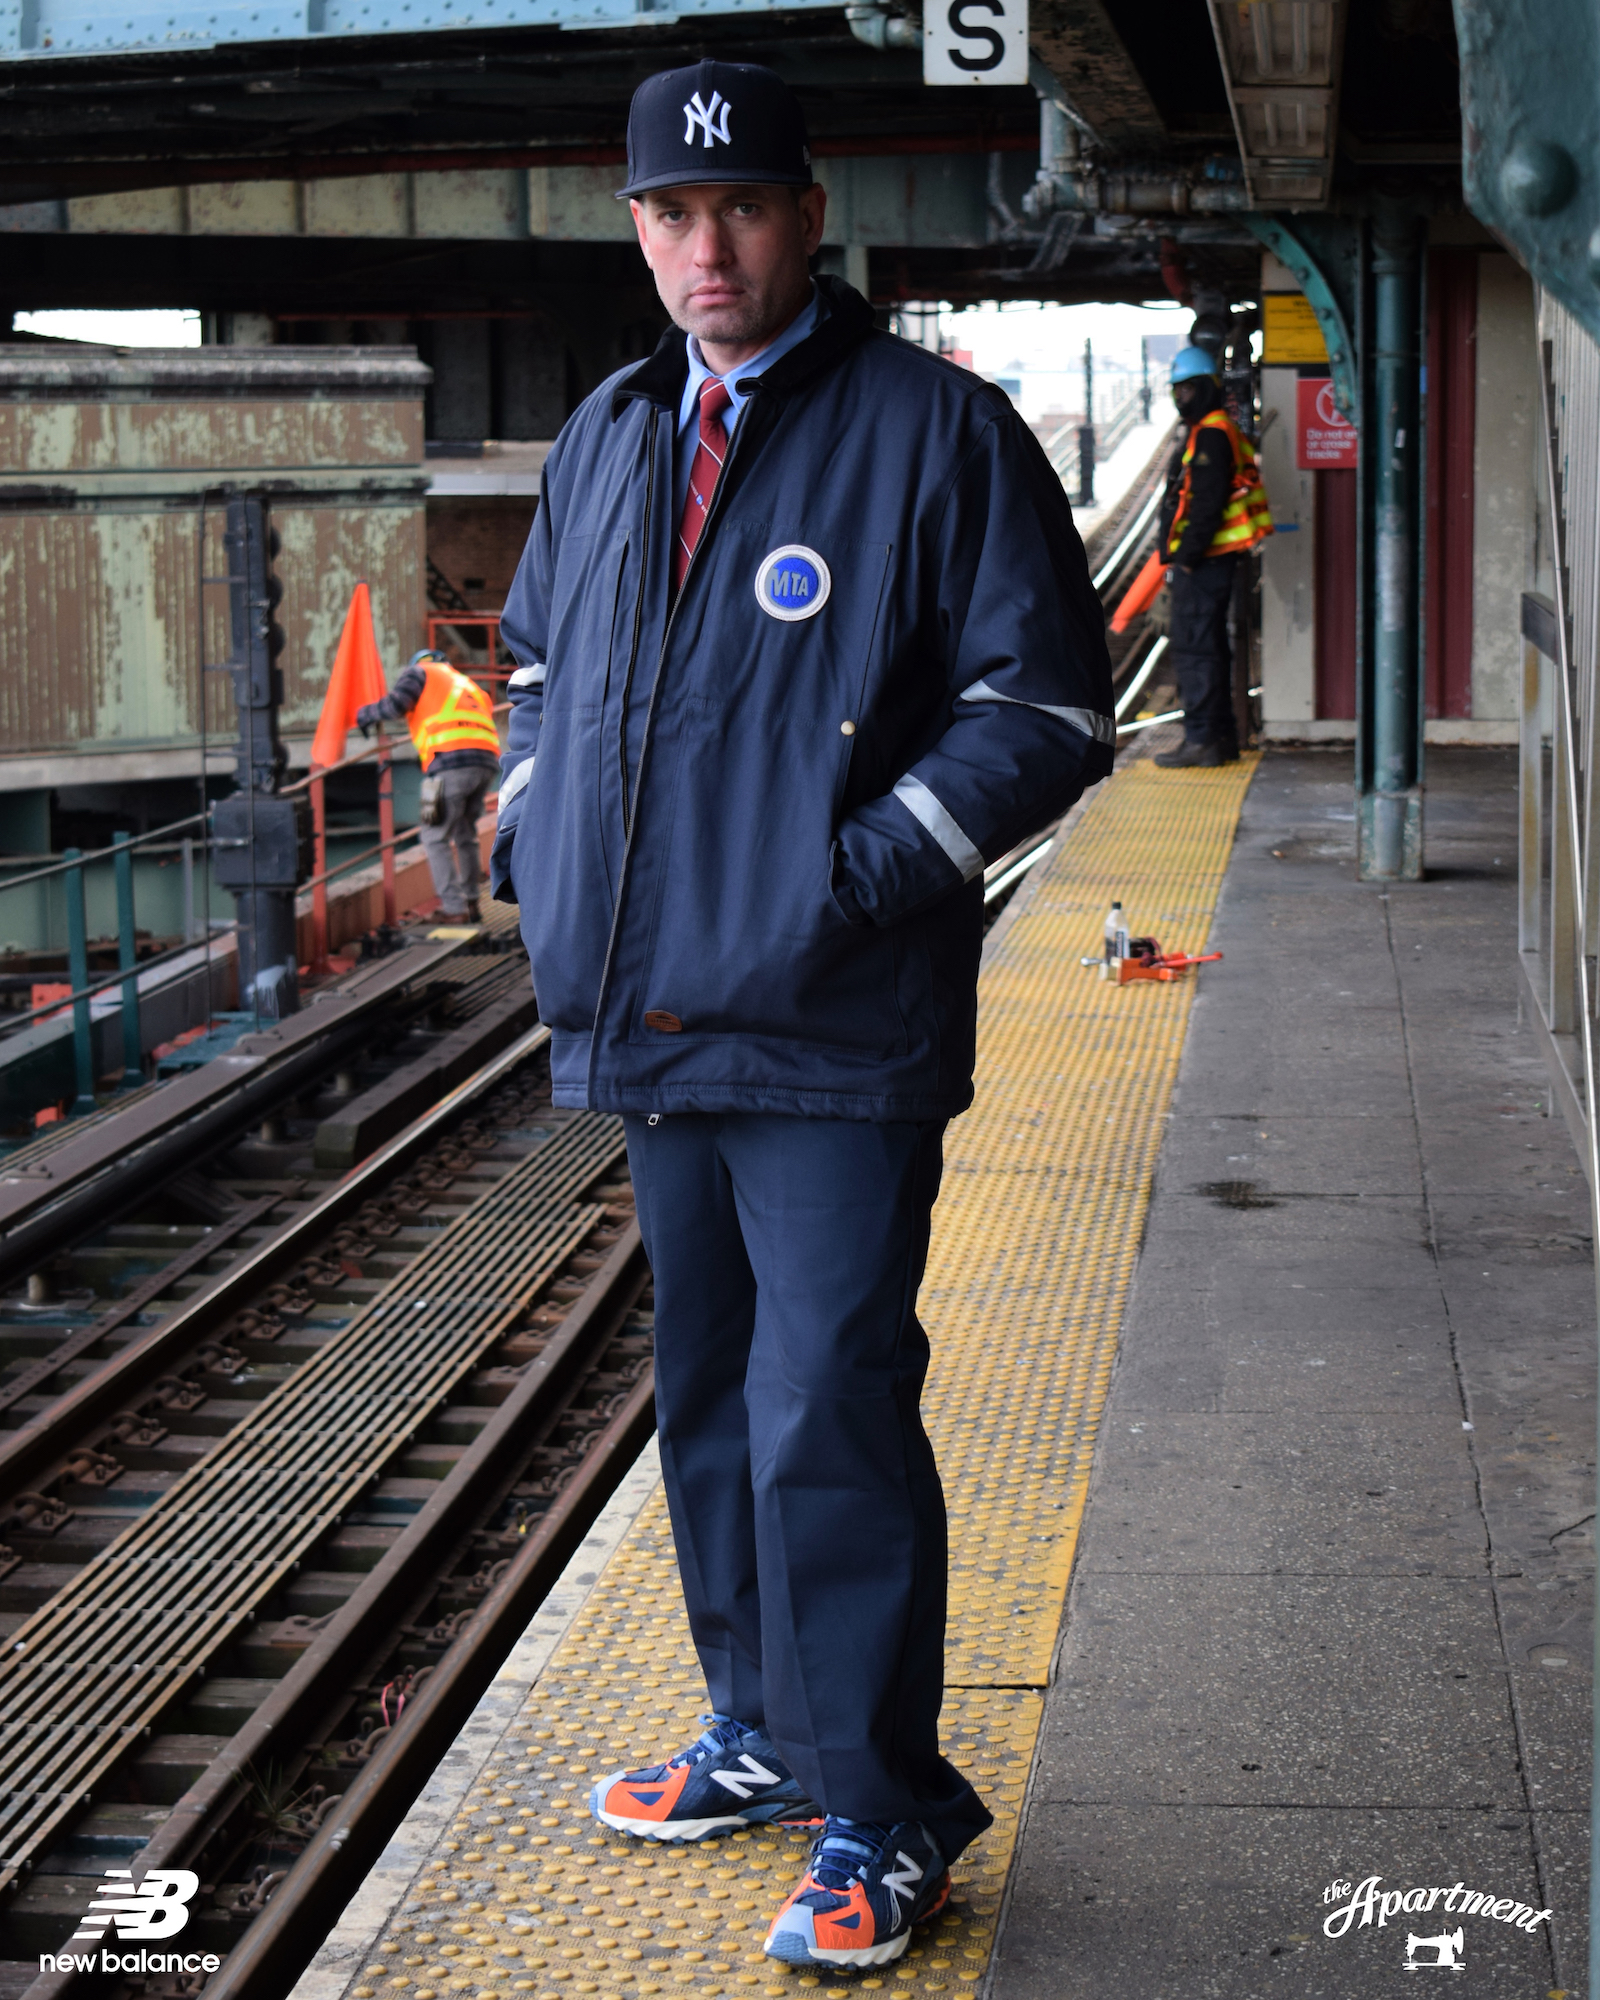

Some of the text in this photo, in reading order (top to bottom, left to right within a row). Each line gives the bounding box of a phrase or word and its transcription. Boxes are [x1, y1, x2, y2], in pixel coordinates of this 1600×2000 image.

[947, 0, 1005, 71] S
[683, 91, 732, 148] NY
[1306, 428, 1322, 440] Do
[1324, 429, 1343, 440] not
[1306, 440, 1352, 449] or cross
[765, 568, 809, 597] MTA
[710, 1753, 781, 1798] N
[881, 1850, 924, 1901] N
